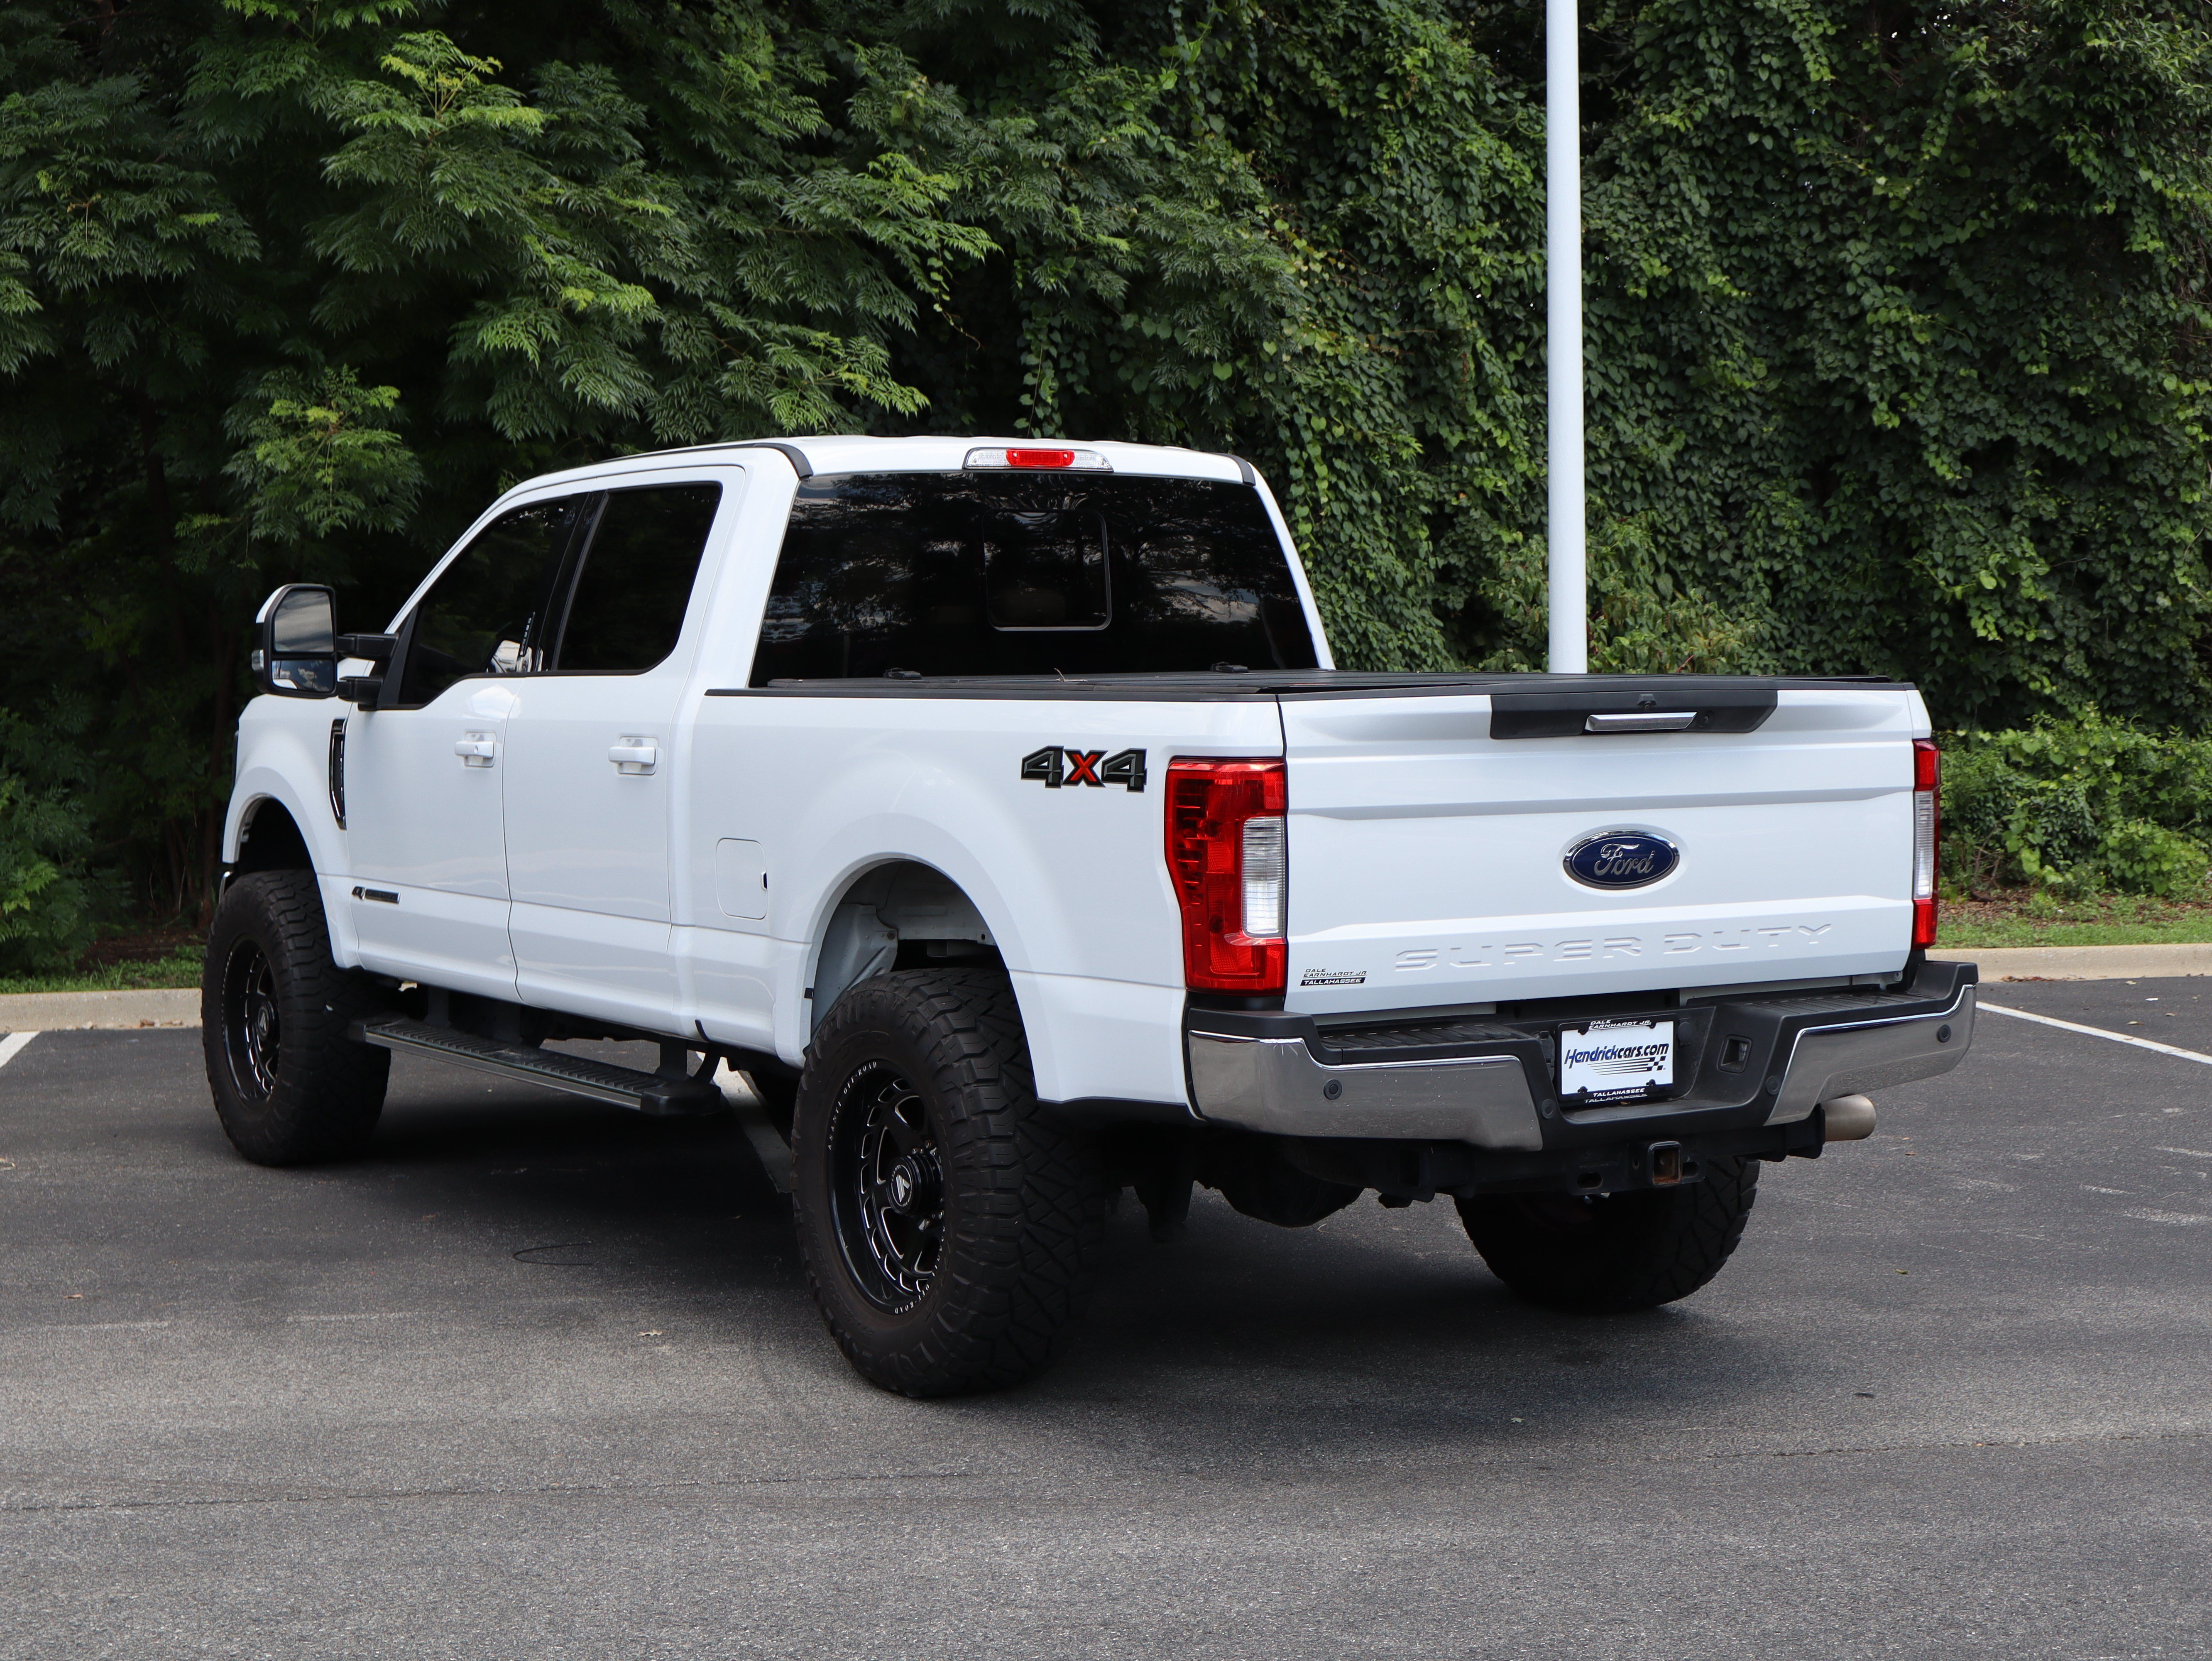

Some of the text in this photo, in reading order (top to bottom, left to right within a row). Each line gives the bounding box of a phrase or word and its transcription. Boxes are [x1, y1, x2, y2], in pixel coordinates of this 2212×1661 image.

[1594, 843, 1656, 876] Ford
[1395, 923, 1833, 973] SUPER DUTY
[1588, 1021, 1638, 1029] EARNHARDT
[1564, 1043, 1669, 1069] Hendrickcars.com
[1593, 1088, 1645, 1097] TALLAHASSEE
